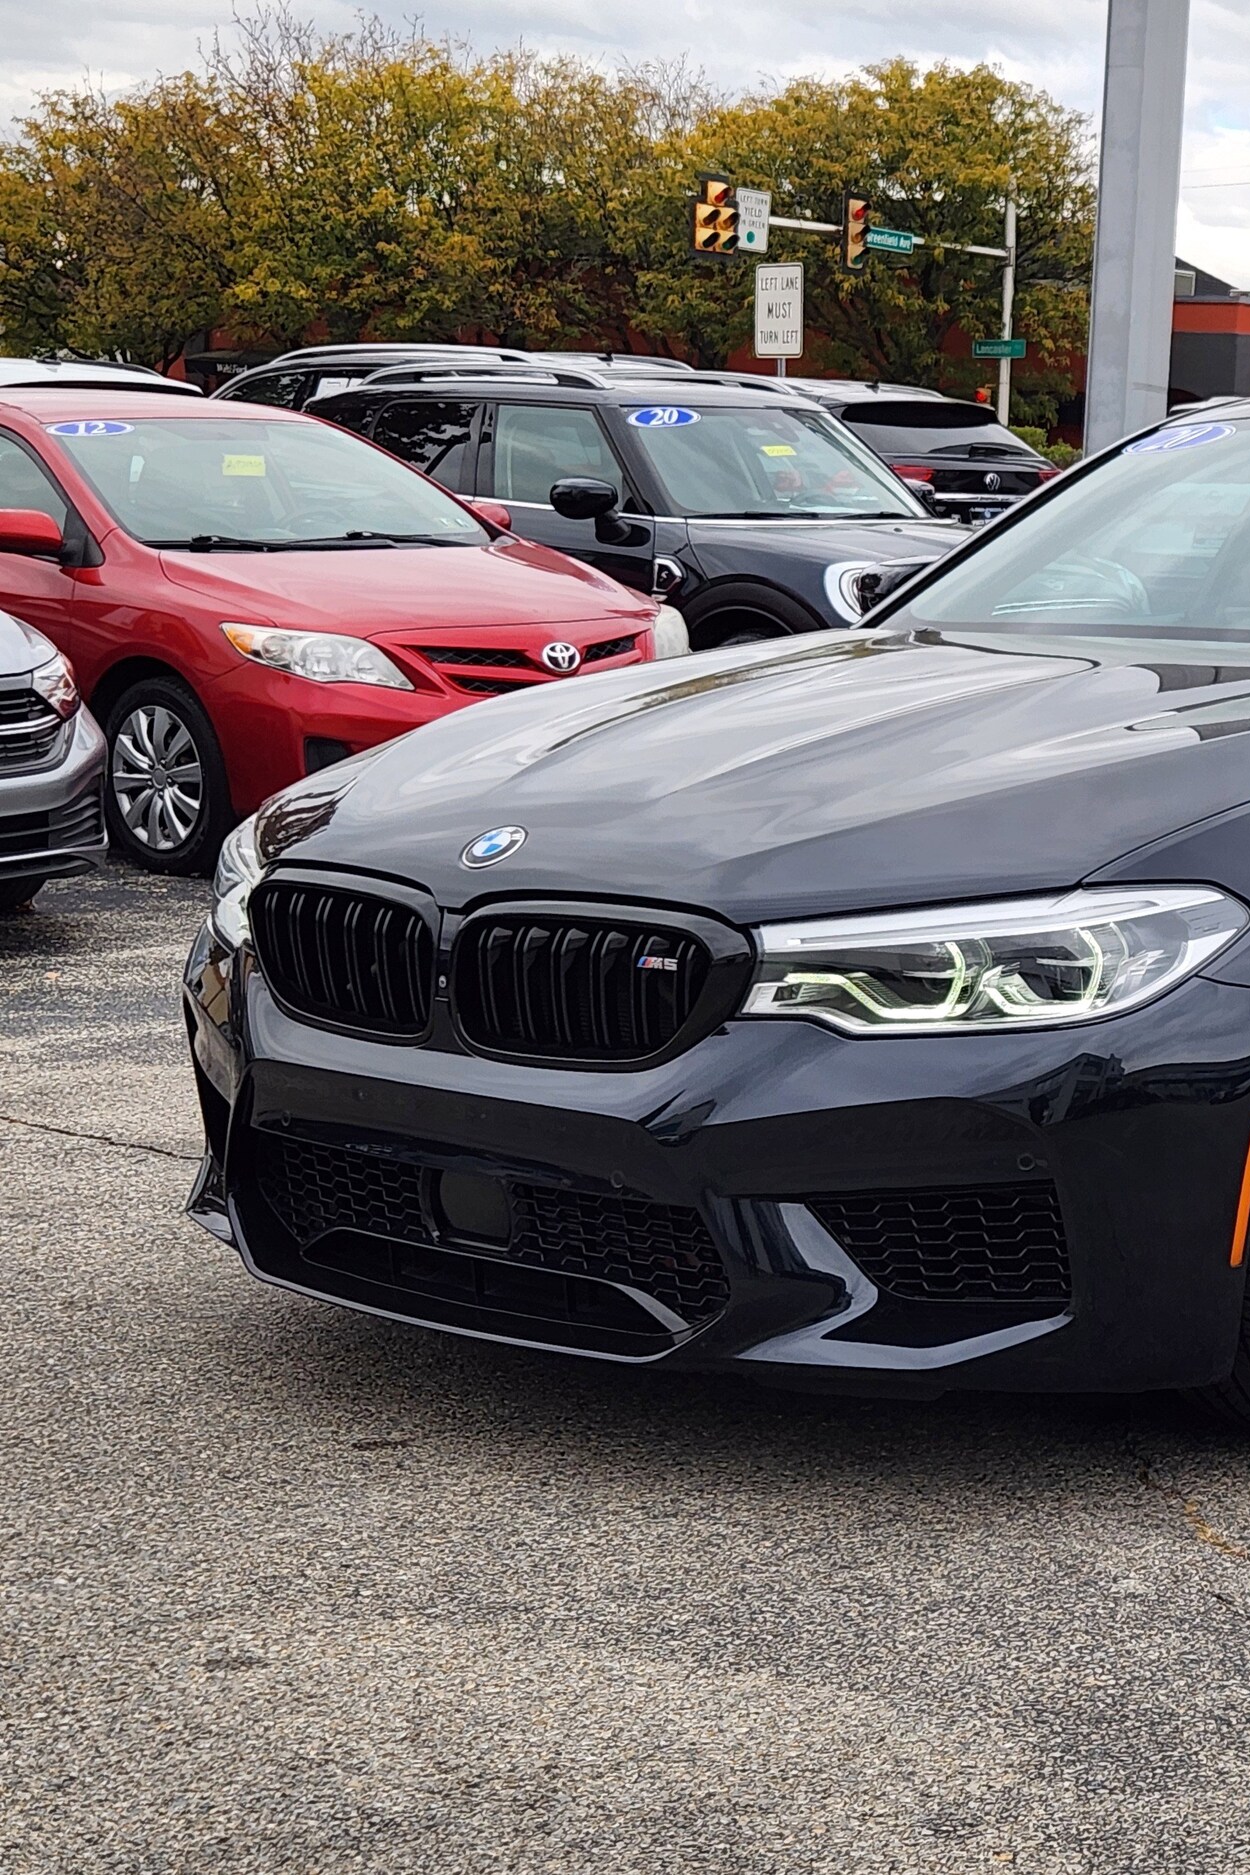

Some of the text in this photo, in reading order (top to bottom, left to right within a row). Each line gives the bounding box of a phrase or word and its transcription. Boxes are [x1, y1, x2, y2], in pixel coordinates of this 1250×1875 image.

[744, 206, 763, 218] YIELD
[761, 276, 799, 291] LEFT LANE
[767, 302, 792, 319] MUST
[760, 330, 799, 344] TURN LEFT
[649, 408, 679, 426] 20
[77, 421, 107, 435] 12
[648, 956, 679, 971] M5
